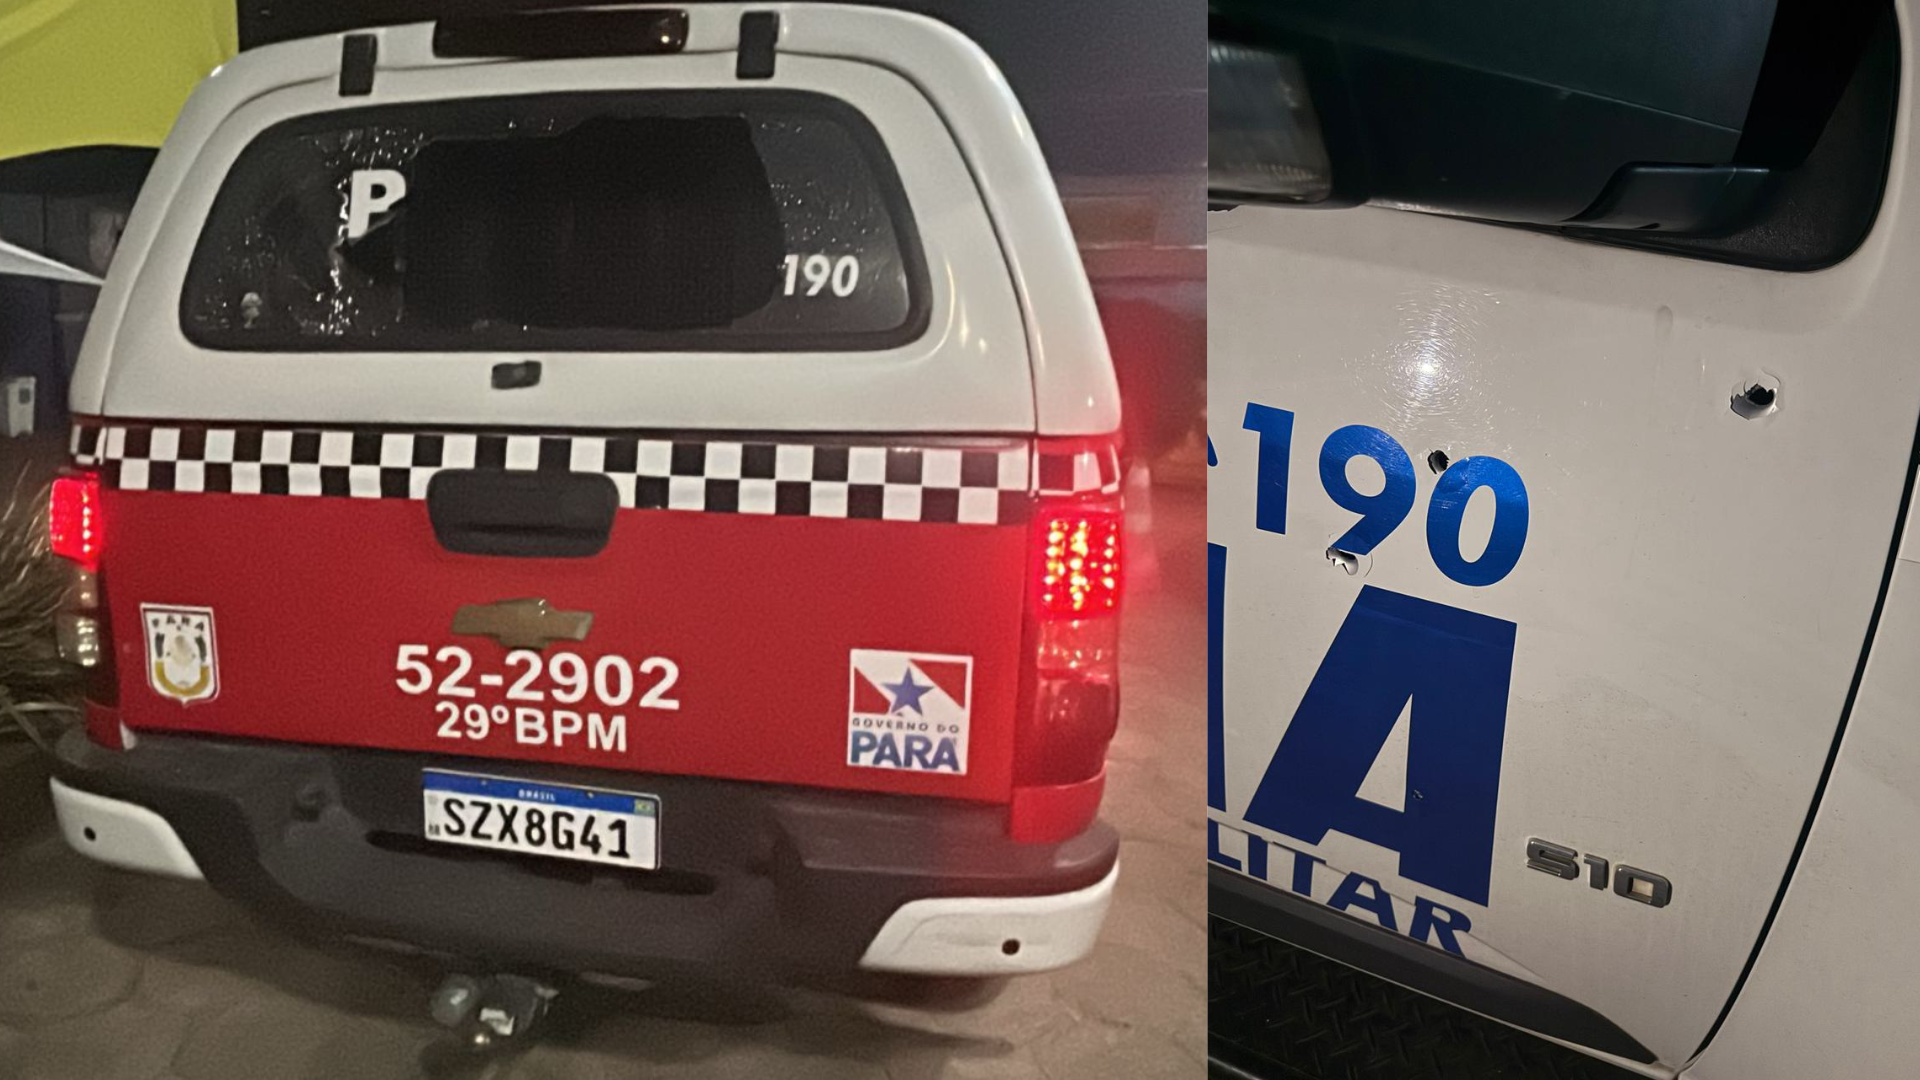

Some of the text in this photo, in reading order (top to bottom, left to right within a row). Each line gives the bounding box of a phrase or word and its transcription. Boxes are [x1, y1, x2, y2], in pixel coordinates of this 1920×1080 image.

[346, 168, 406, 239] P
[783, 254, 859, 297] 190
[1243, 402, 1529, 586] 190
[396, 644, 680, 710] 52-2902
[852, 717, 960, 734] GOVERNO DO
[1208, 542, 1517, 908] A
[443, 798, 630, 859] SZX8G41
[1526, 838, 1672, 908] S10
